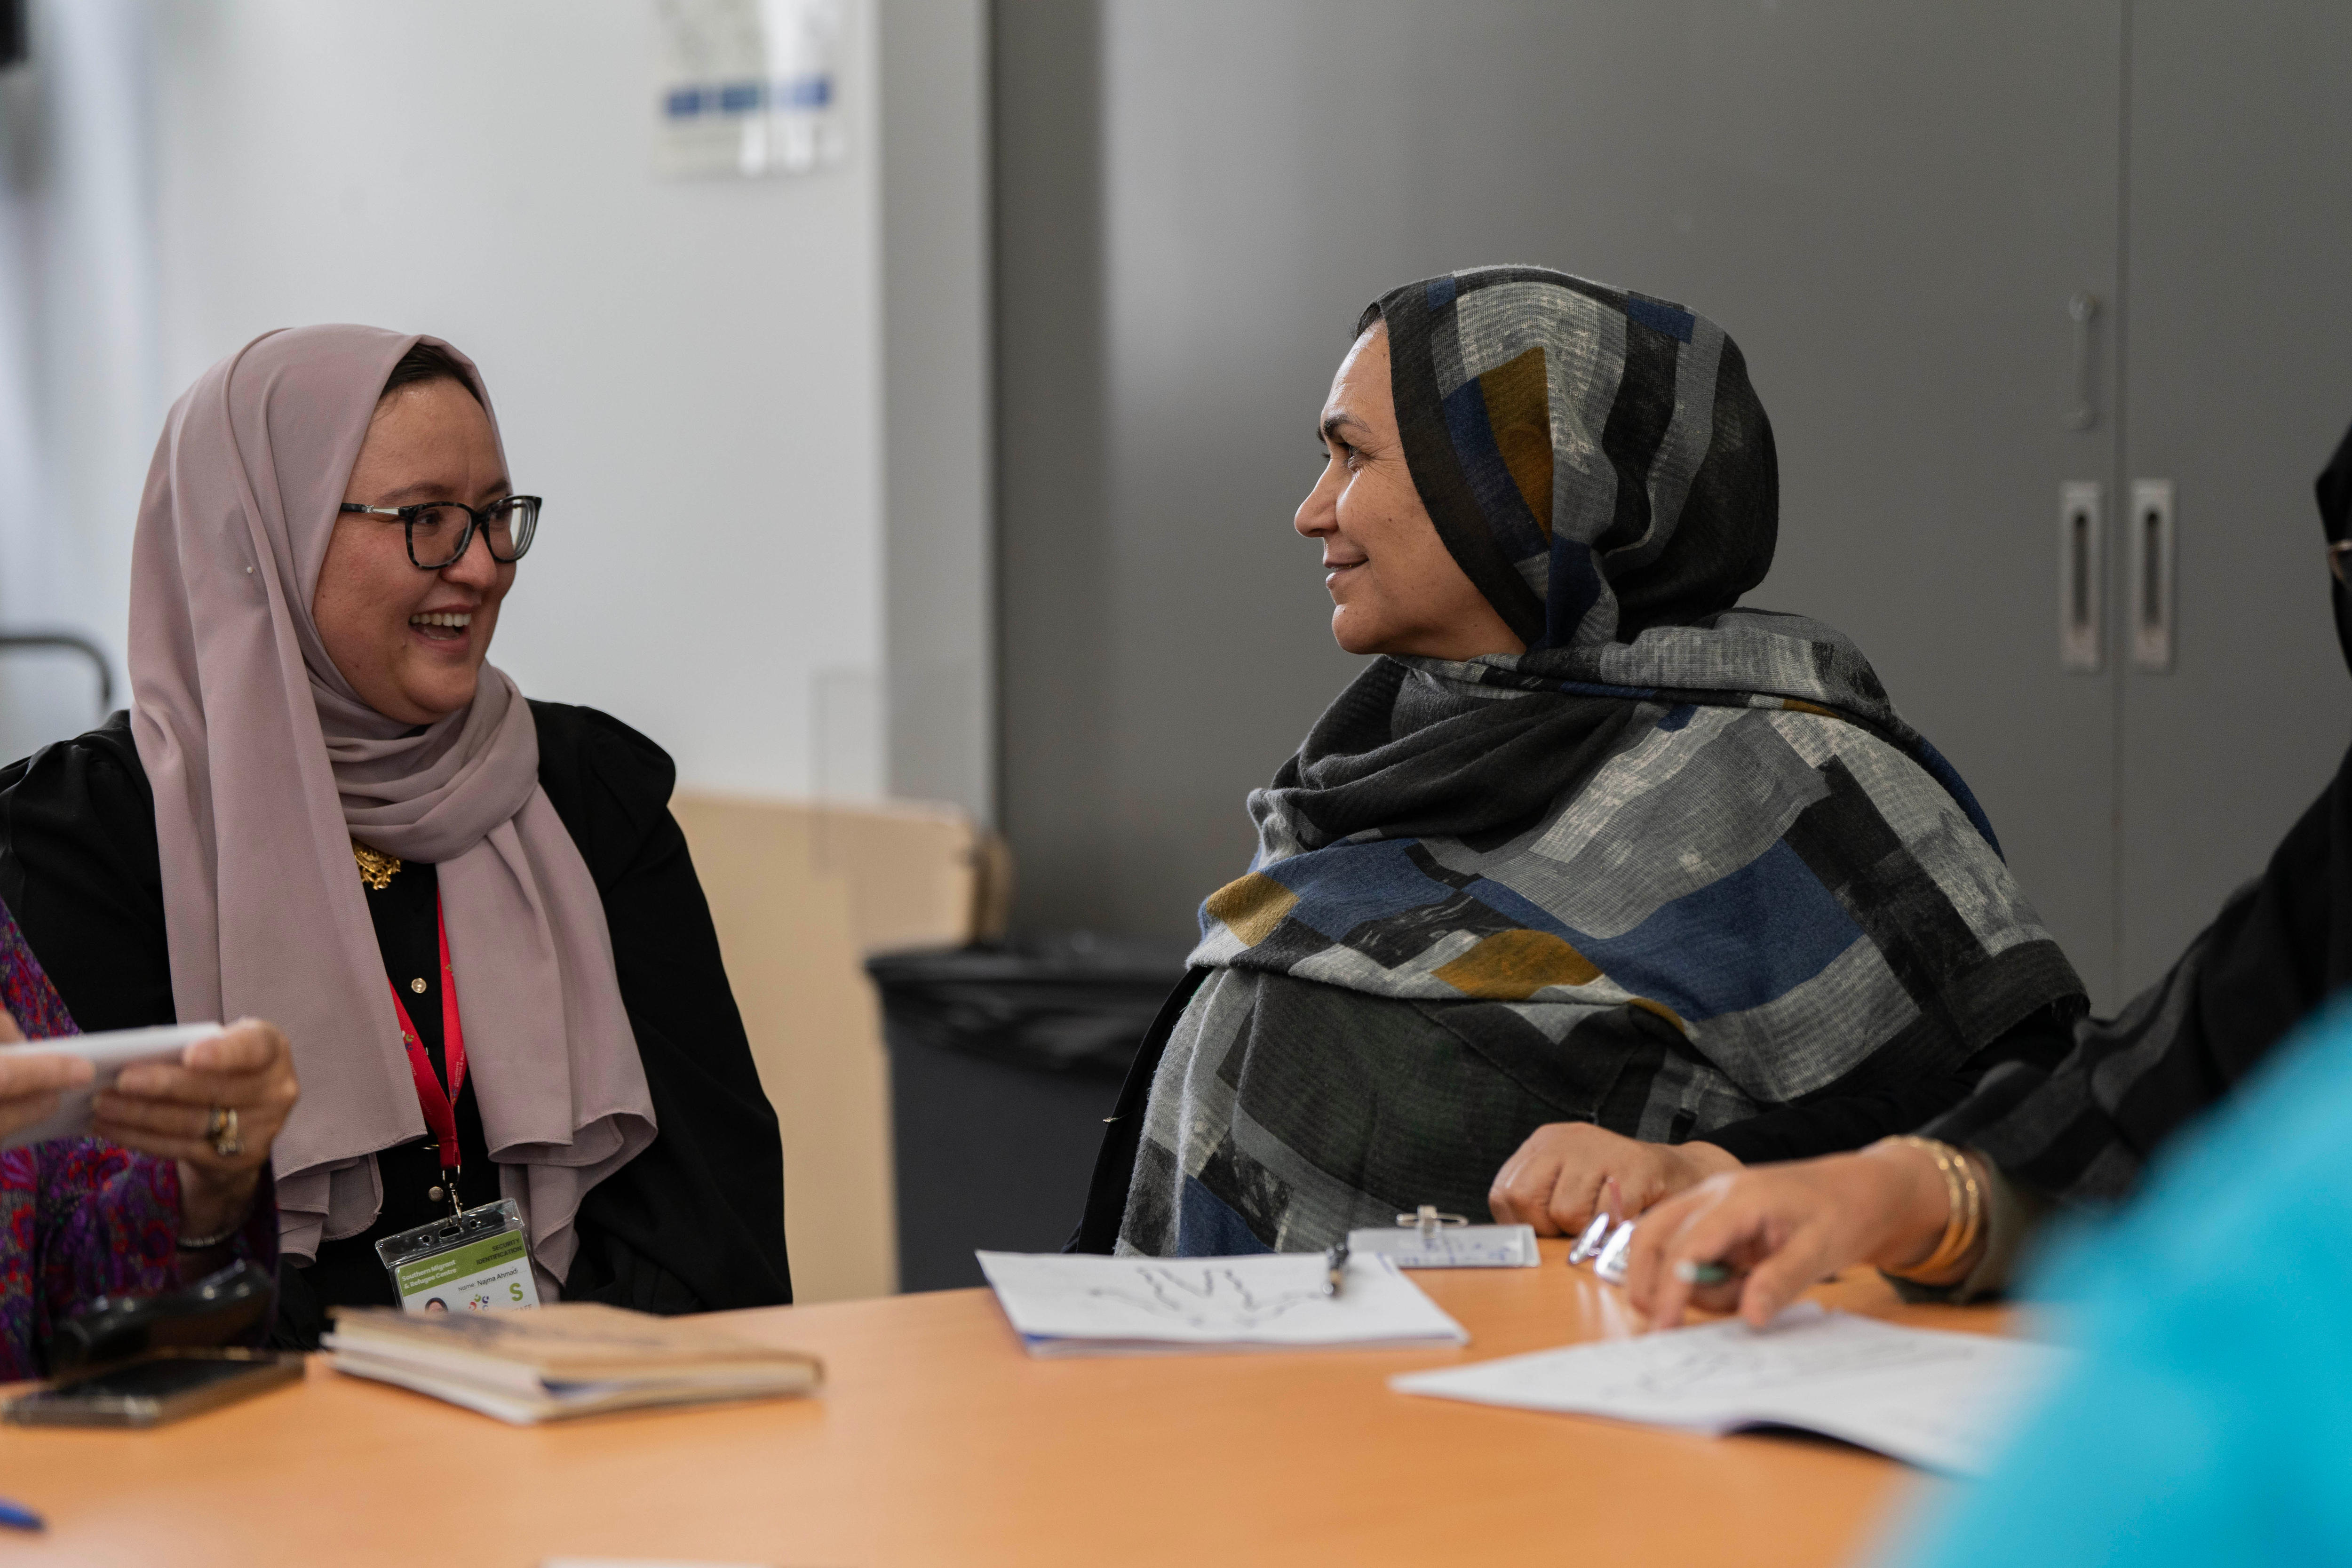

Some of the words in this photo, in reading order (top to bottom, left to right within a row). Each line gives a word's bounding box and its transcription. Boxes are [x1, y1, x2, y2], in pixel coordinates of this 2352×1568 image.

[492, 1238, 519, 1251] SECURITY
[476, 1246, 522, 1265] IDENTIFICATION
[402, 1269, 431, 1281] Southern
[431, 1260, 456, 1272] Migrant
[410, 1275, 436, 1287] Refugee
[436, 1269, 457, 1278] Centre
[458, 1282, 476, 1291] Name:
[477, 1274, 496, 1286] Najma
[497, 1266, 519, 1280] Ahmadi
[509, 1282, 523, 1302] S
